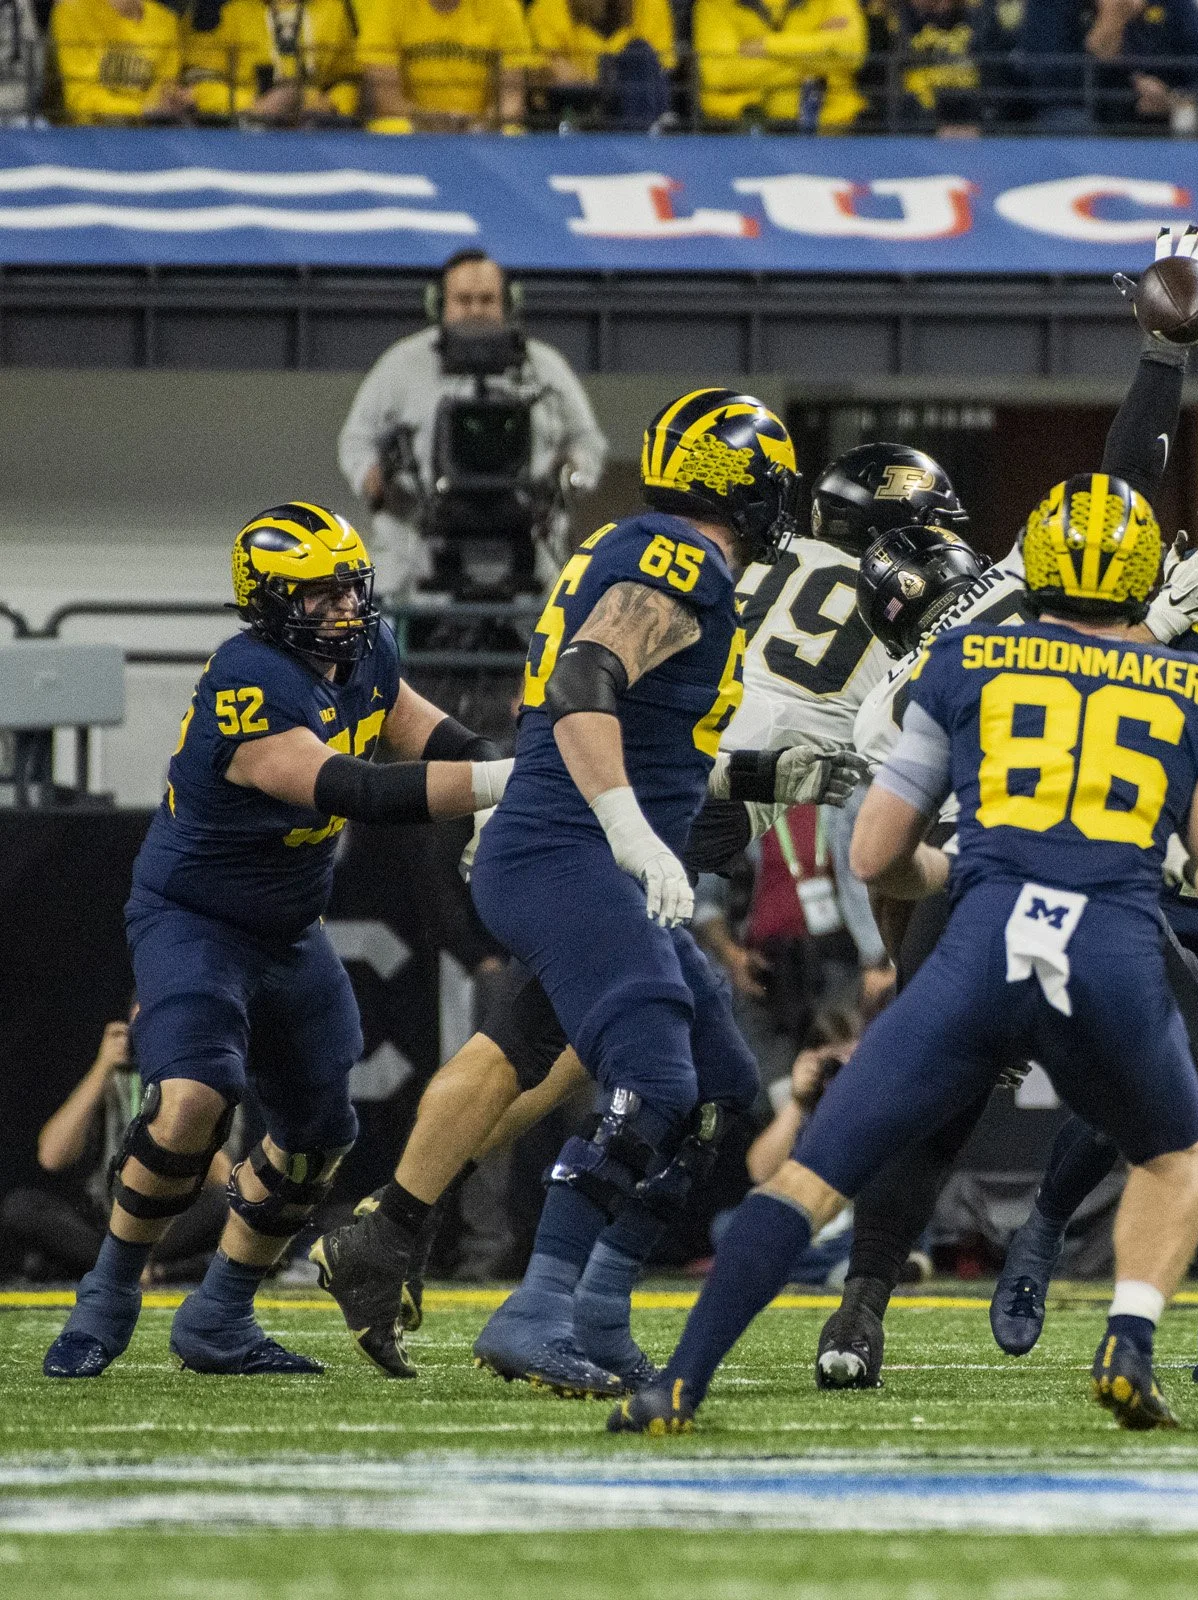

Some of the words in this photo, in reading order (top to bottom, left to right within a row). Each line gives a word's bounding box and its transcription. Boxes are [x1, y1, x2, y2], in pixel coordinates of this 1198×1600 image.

[874, 465, 936, 500] P
[638, 534, 706, 593] 65
[215, 686, 269, 736] 52
[975, 671, 1186, 850] 86
[1024, 896, 1070, 930] M
